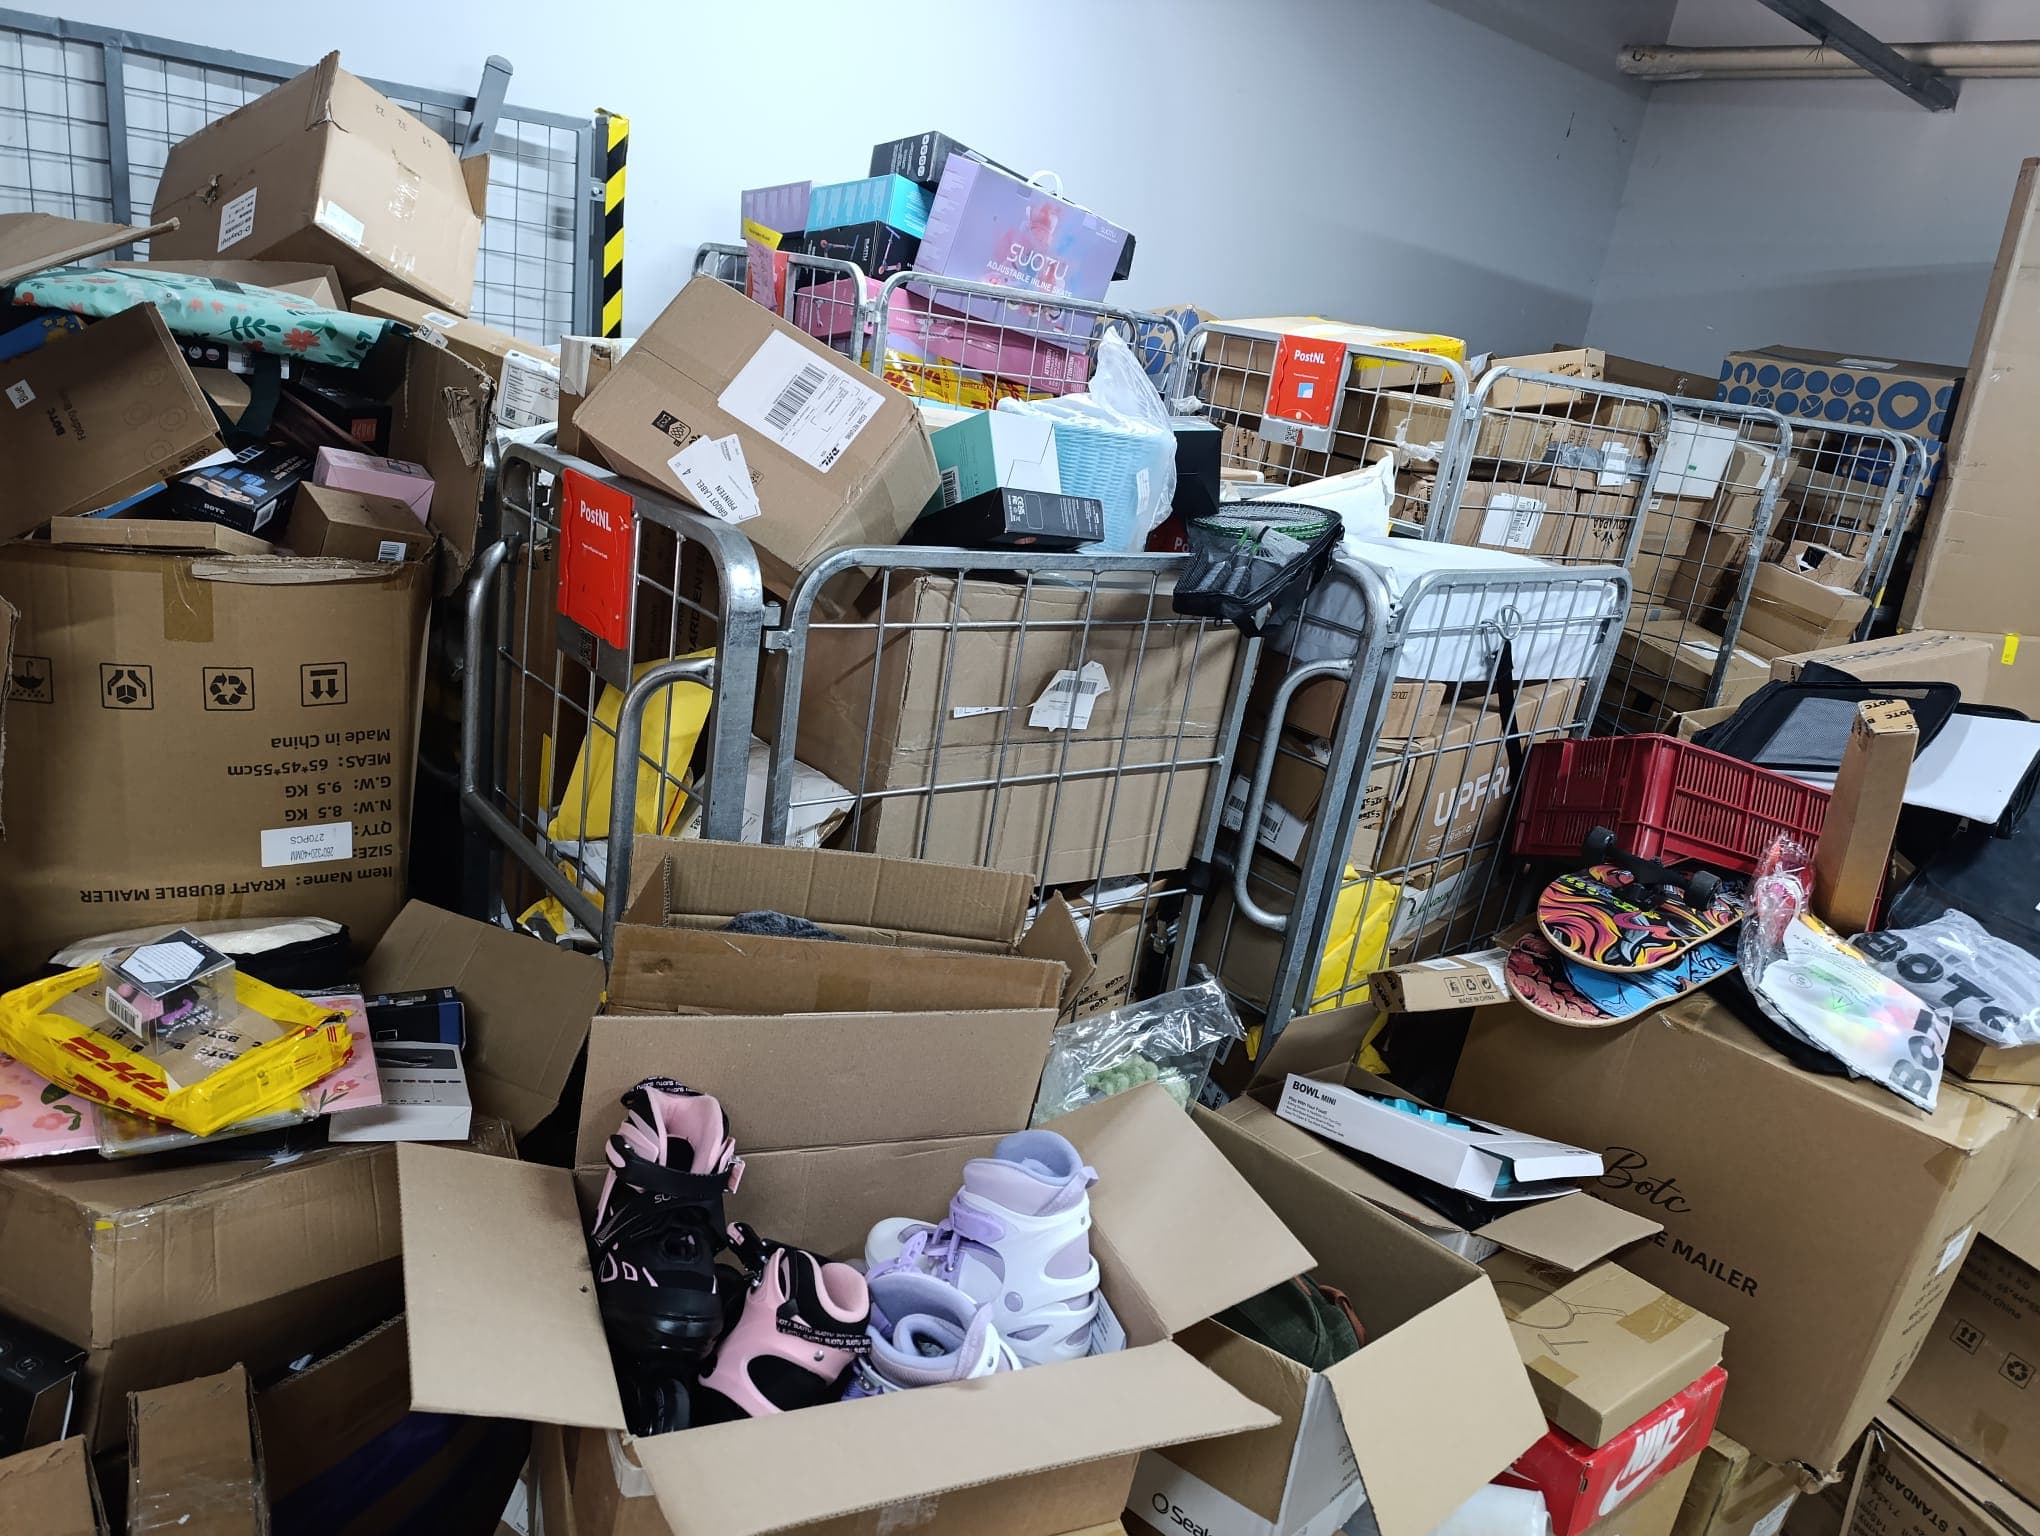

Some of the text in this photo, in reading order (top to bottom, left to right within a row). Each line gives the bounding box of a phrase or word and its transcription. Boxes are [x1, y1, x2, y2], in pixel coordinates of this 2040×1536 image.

[1006, 242, 1069, 280] SUOTU
[986, 260, 1031, 284] ADJUSTABLE
[1030, 277, 1052, 291] INLINE
[1293, 350, 1327, 365] PostNL
[14, 385, 30, 404] Blue
[820, 446, 840, 466] DHL
[682, 468, 728, 518] GROOT LABEL 4
[714, 484, 738, 512] PRINTEN
[580, 499, 613, 533] PostNL
[271, 728, 391, 749] Made in China
[338, 752, 391, 768] MEAS:
[284, 775, 392, 798] G.W: 9.5 KG
[284, 799, 392, 822] N.W: 8.5 KG
[289, 832, 325, 845] 270PCS
[353, 821, 392, 837] QTY:
[353, 843, 393, 858] SIZE:
[80, 866, 393, 904] Item Name: KRAFT BUBBLE MAILER
[199, 1029, 241, 1043] BOTC
[61, 1035, 171, 1102] DHL
[1292, 1080, 1337, 1107] BOWL MINI
[1599, 1146, 1692, 1213] Botc
[1671, 1238, 1758, 1297] MAILER
[1619, 1407, 1686, 1483] NIKE
[1875, 1462, 1949, 1532] STANDARD
